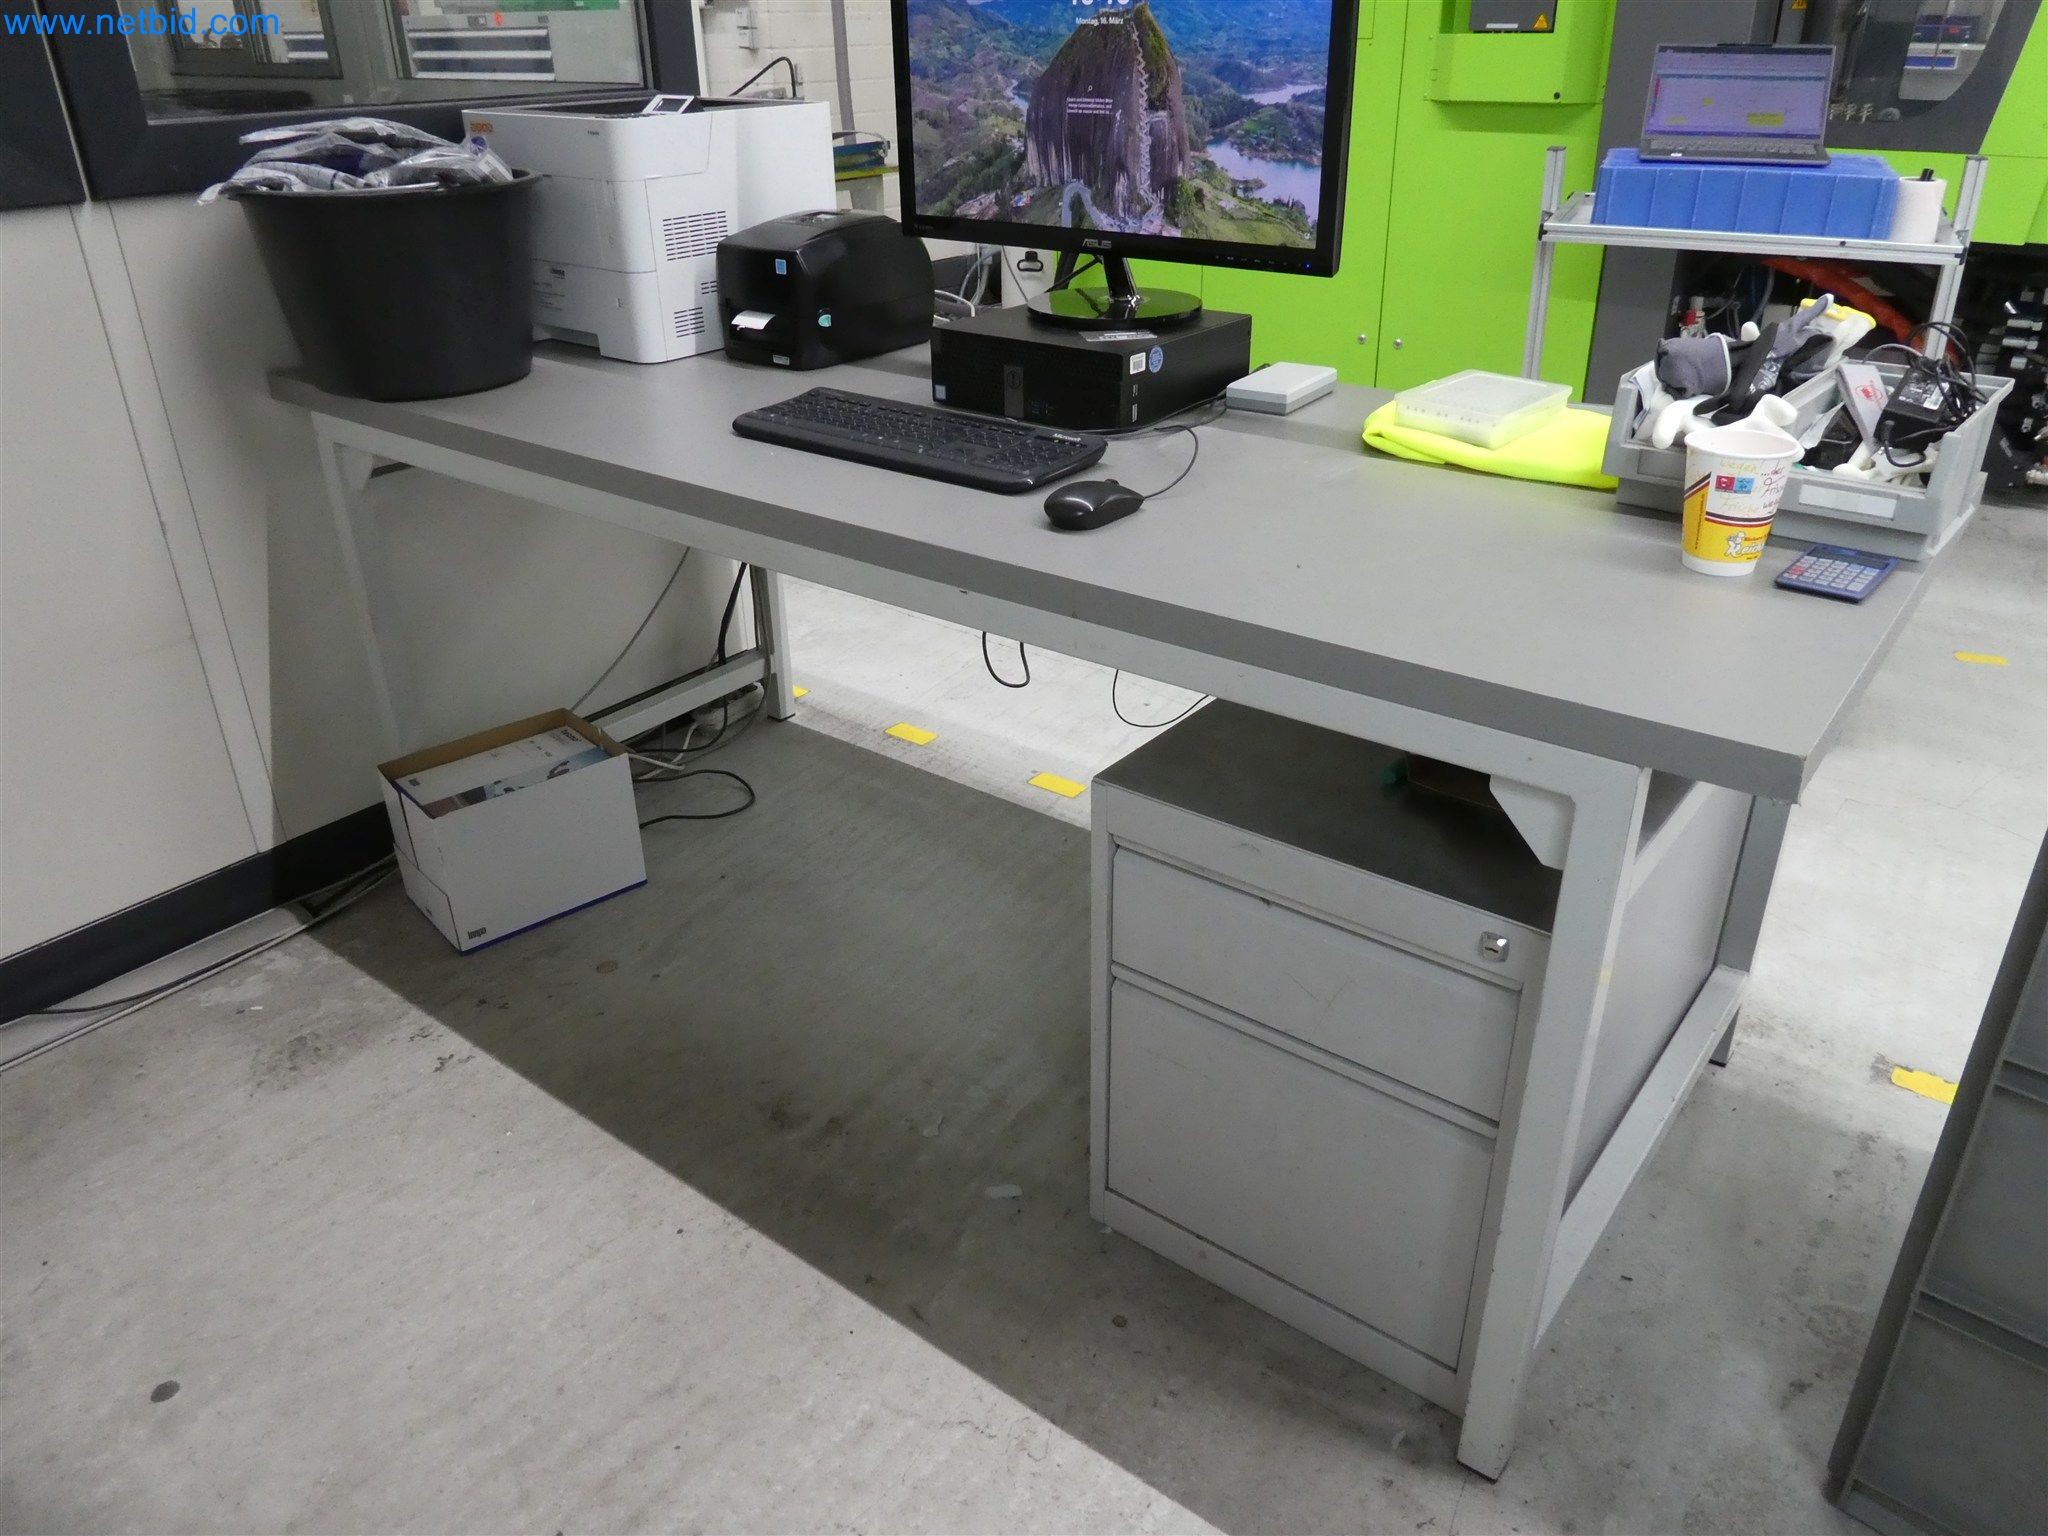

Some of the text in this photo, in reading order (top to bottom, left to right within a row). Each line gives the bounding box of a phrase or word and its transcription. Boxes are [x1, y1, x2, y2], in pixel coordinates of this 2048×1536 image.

[1075, 17, 1099, 27] Montag,
[1109, 16, 1124, 25] März
[1082, 238, 1112, 249] ASUS
